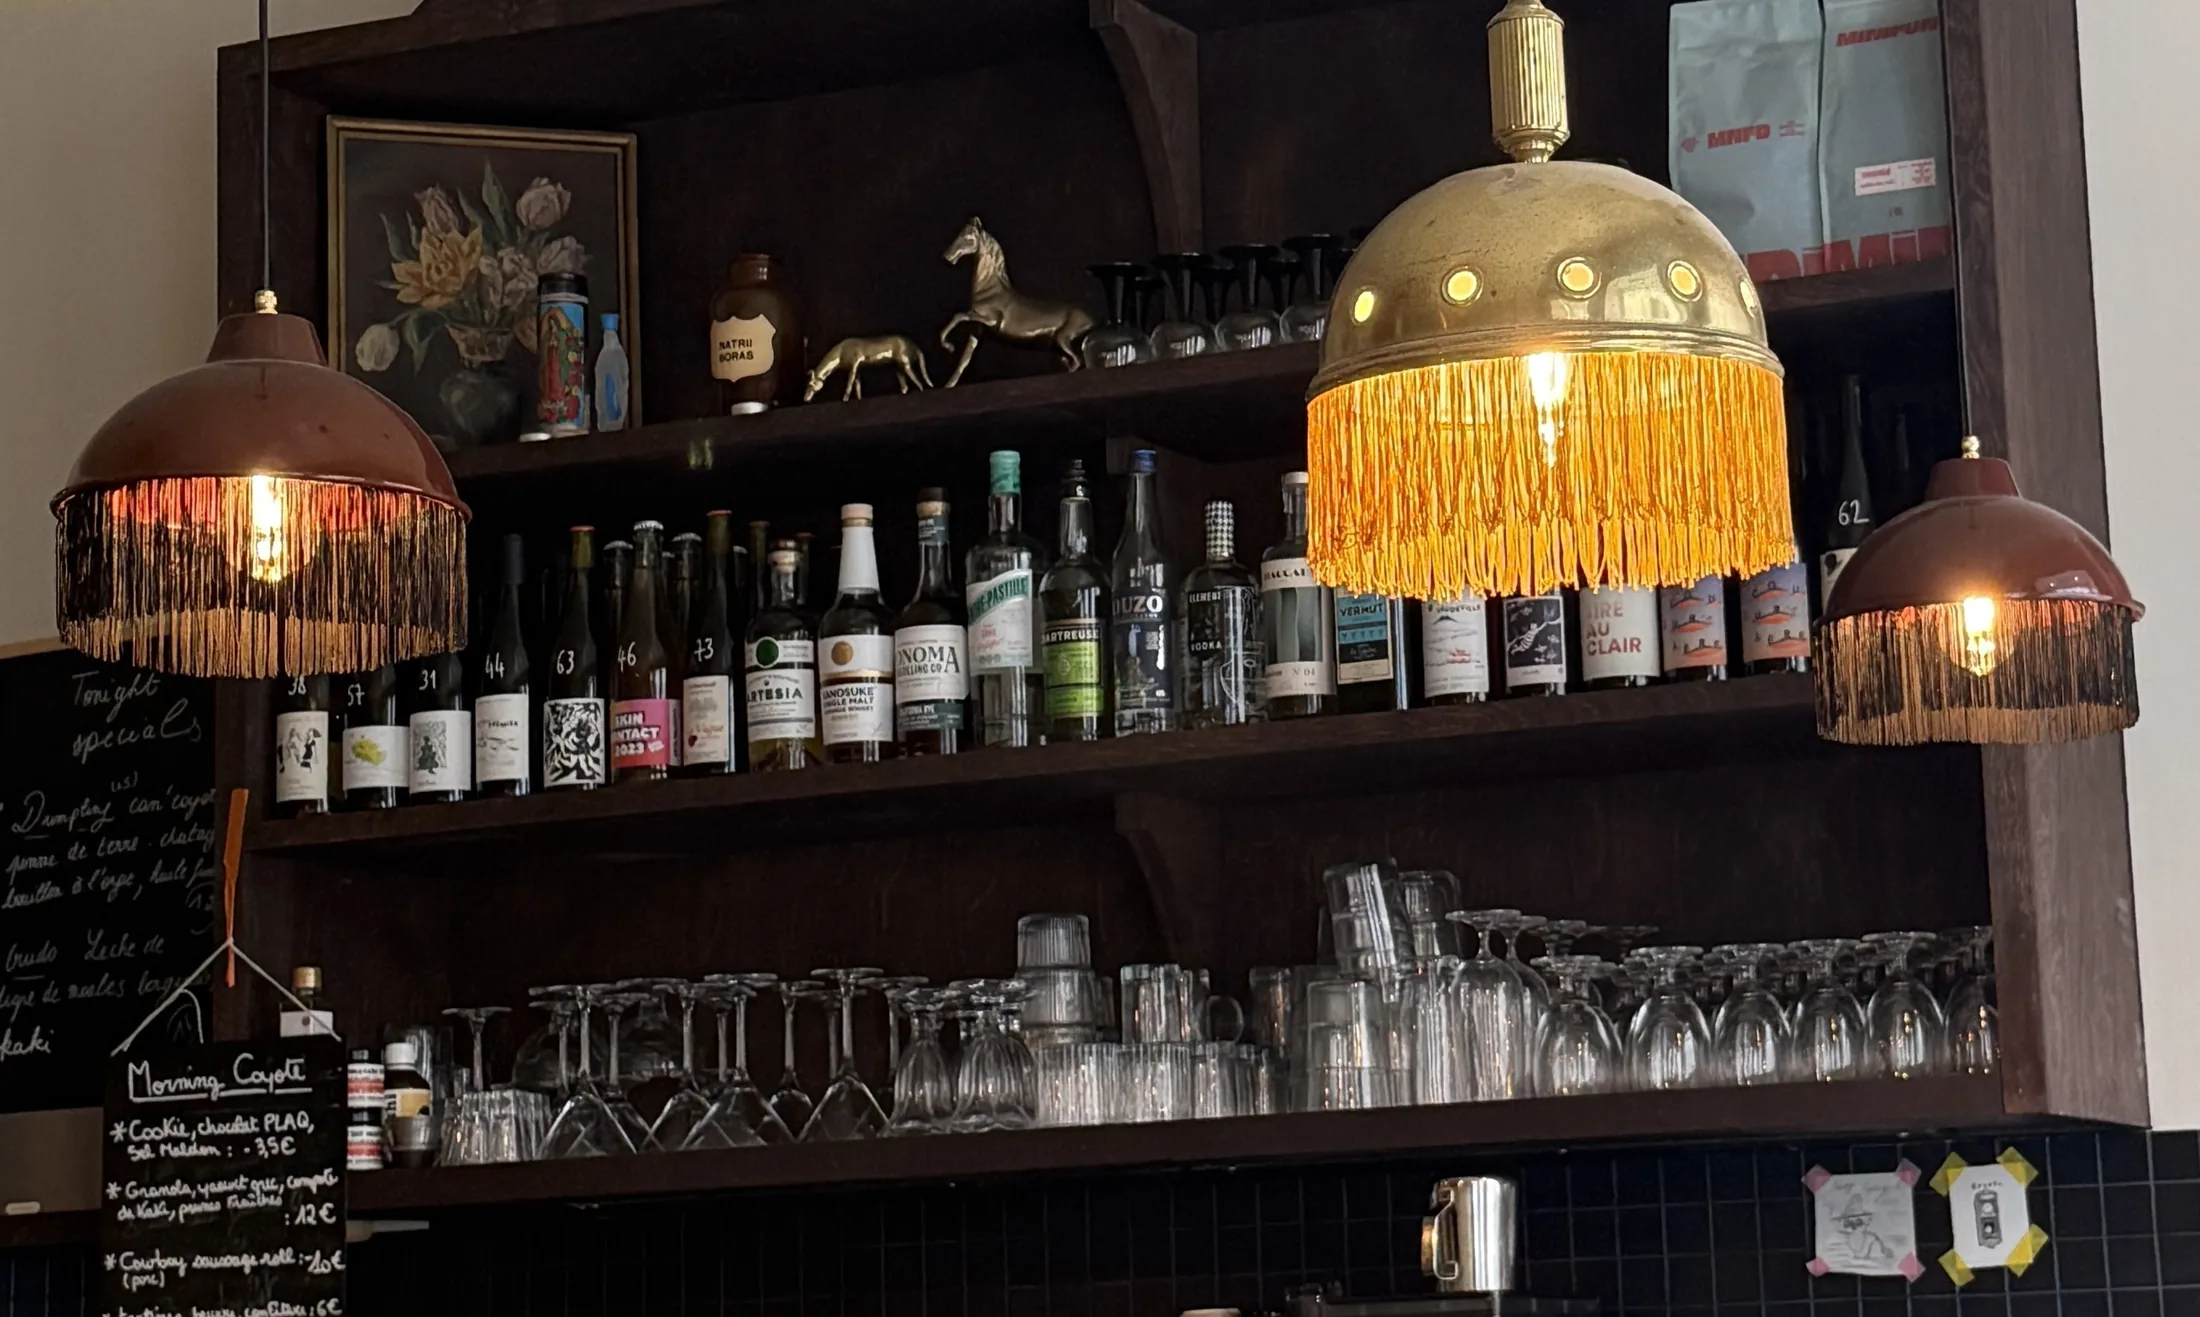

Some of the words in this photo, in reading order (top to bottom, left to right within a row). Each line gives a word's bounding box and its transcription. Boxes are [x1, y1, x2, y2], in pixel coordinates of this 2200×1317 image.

[719, 339, 753, 351] NATRII
[719, 351, 754, 363] BORAS
[1838, 499, 1869, 525] 62
[1340, 603, 1383, 617] VERMUT
[1041, 629, 1100, 644] ARTREUSE
[1586, 622, 1609, 639] AU
[617, 641, 637, 674] 46
[1587, 637, 1642, 656] CLAIR
[485, 652, 505, 679] 44
[556, 649, 576, 675] 63
[71, 669, 162, 724] Tonight
[347, 683, 365, 707] 57
[72, 697, 203, 765] specials
[613, 727, 660, 742] NTACT
[67, 840, 89, 861] de
[143, 933, 165, 955] de
[42, 979, 62, 1004] de
[128, 1060, 225, 1101] Morning
[233, 1053, 306, 1092] Coyote
[127, 1143, 156, 1160] Sel
[117, 1205, 135, 1221] de
[119, 1249, 188, 1278] Cowboy
[260, 1247, 296, 1265] roll
[122, 1270, 165, 1293] (porc)
